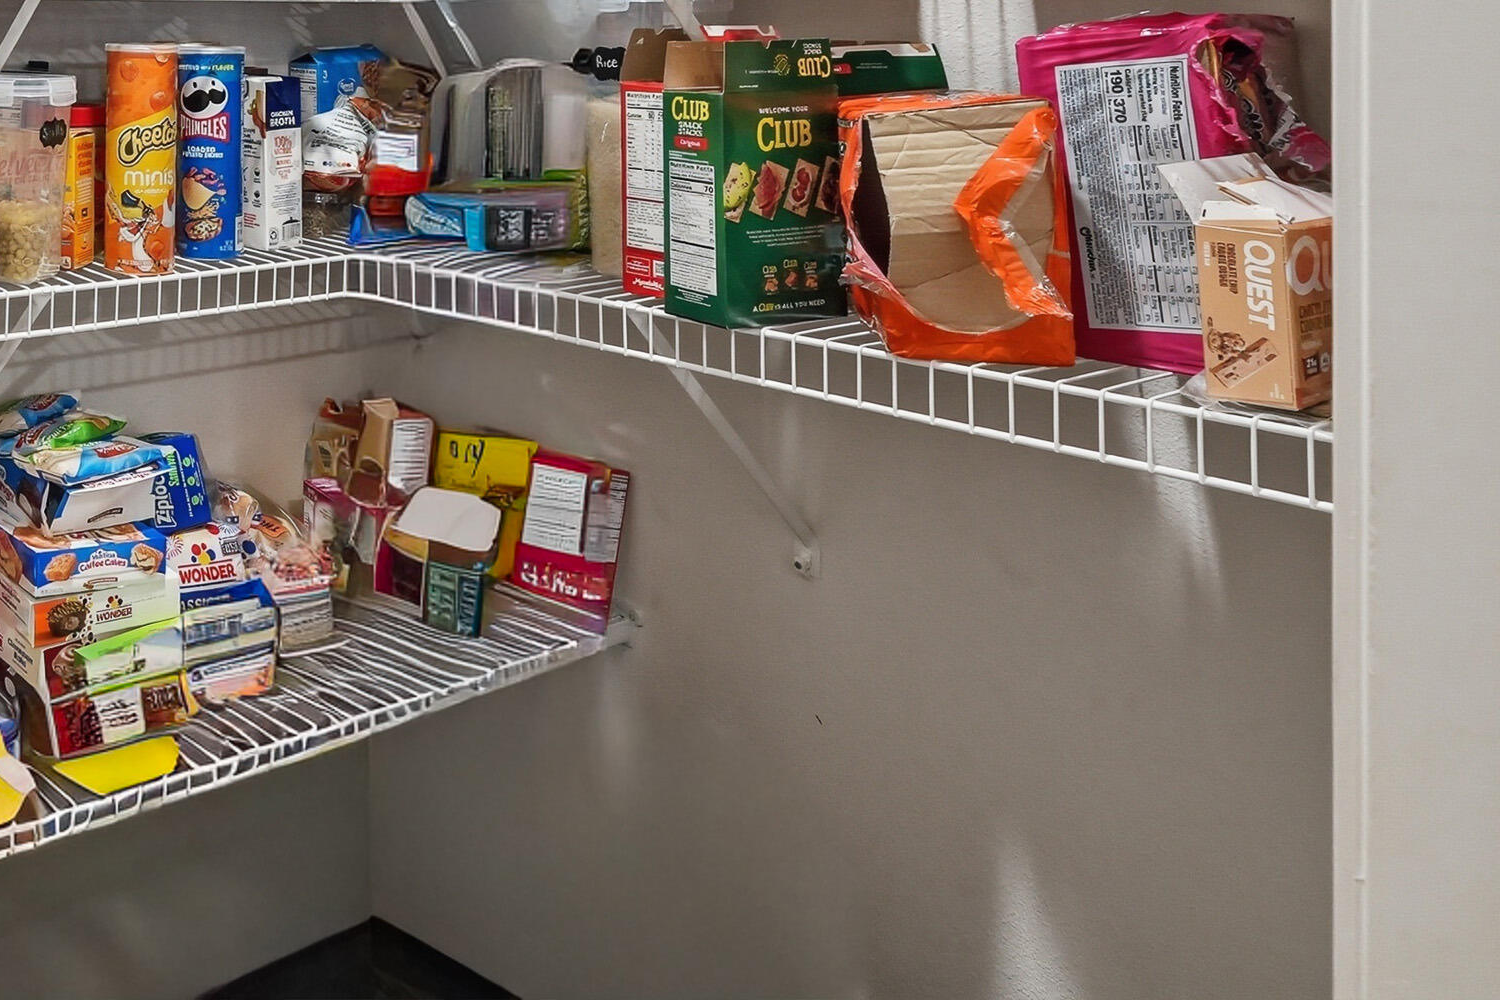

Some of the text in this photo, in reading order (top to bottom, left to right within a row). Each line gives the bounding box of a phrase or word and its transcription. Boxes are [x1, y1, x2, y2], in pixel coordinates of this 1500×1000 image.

[596, 54, 619, 69] Rice
[797, 55, 831, 78] CLUB
[1169, 66, 1181, 98] Nutrition
[671, 96, 710, 121] CLUB
[1110, 70, 1127, 123] 190 370
[180, 113, 228, 140] PRINGLES
[270, 118, 296, 127] BROTH
[757, 117, 812, 152] CLUB
[124, 167, 173, 187] minis
[1243, 239, 1276, 331] QUEST
[154, 475, 177, 528] Ziploc
[179, 563, 237, 585] WONDER
[96, 607, 133, 623] WONDER
